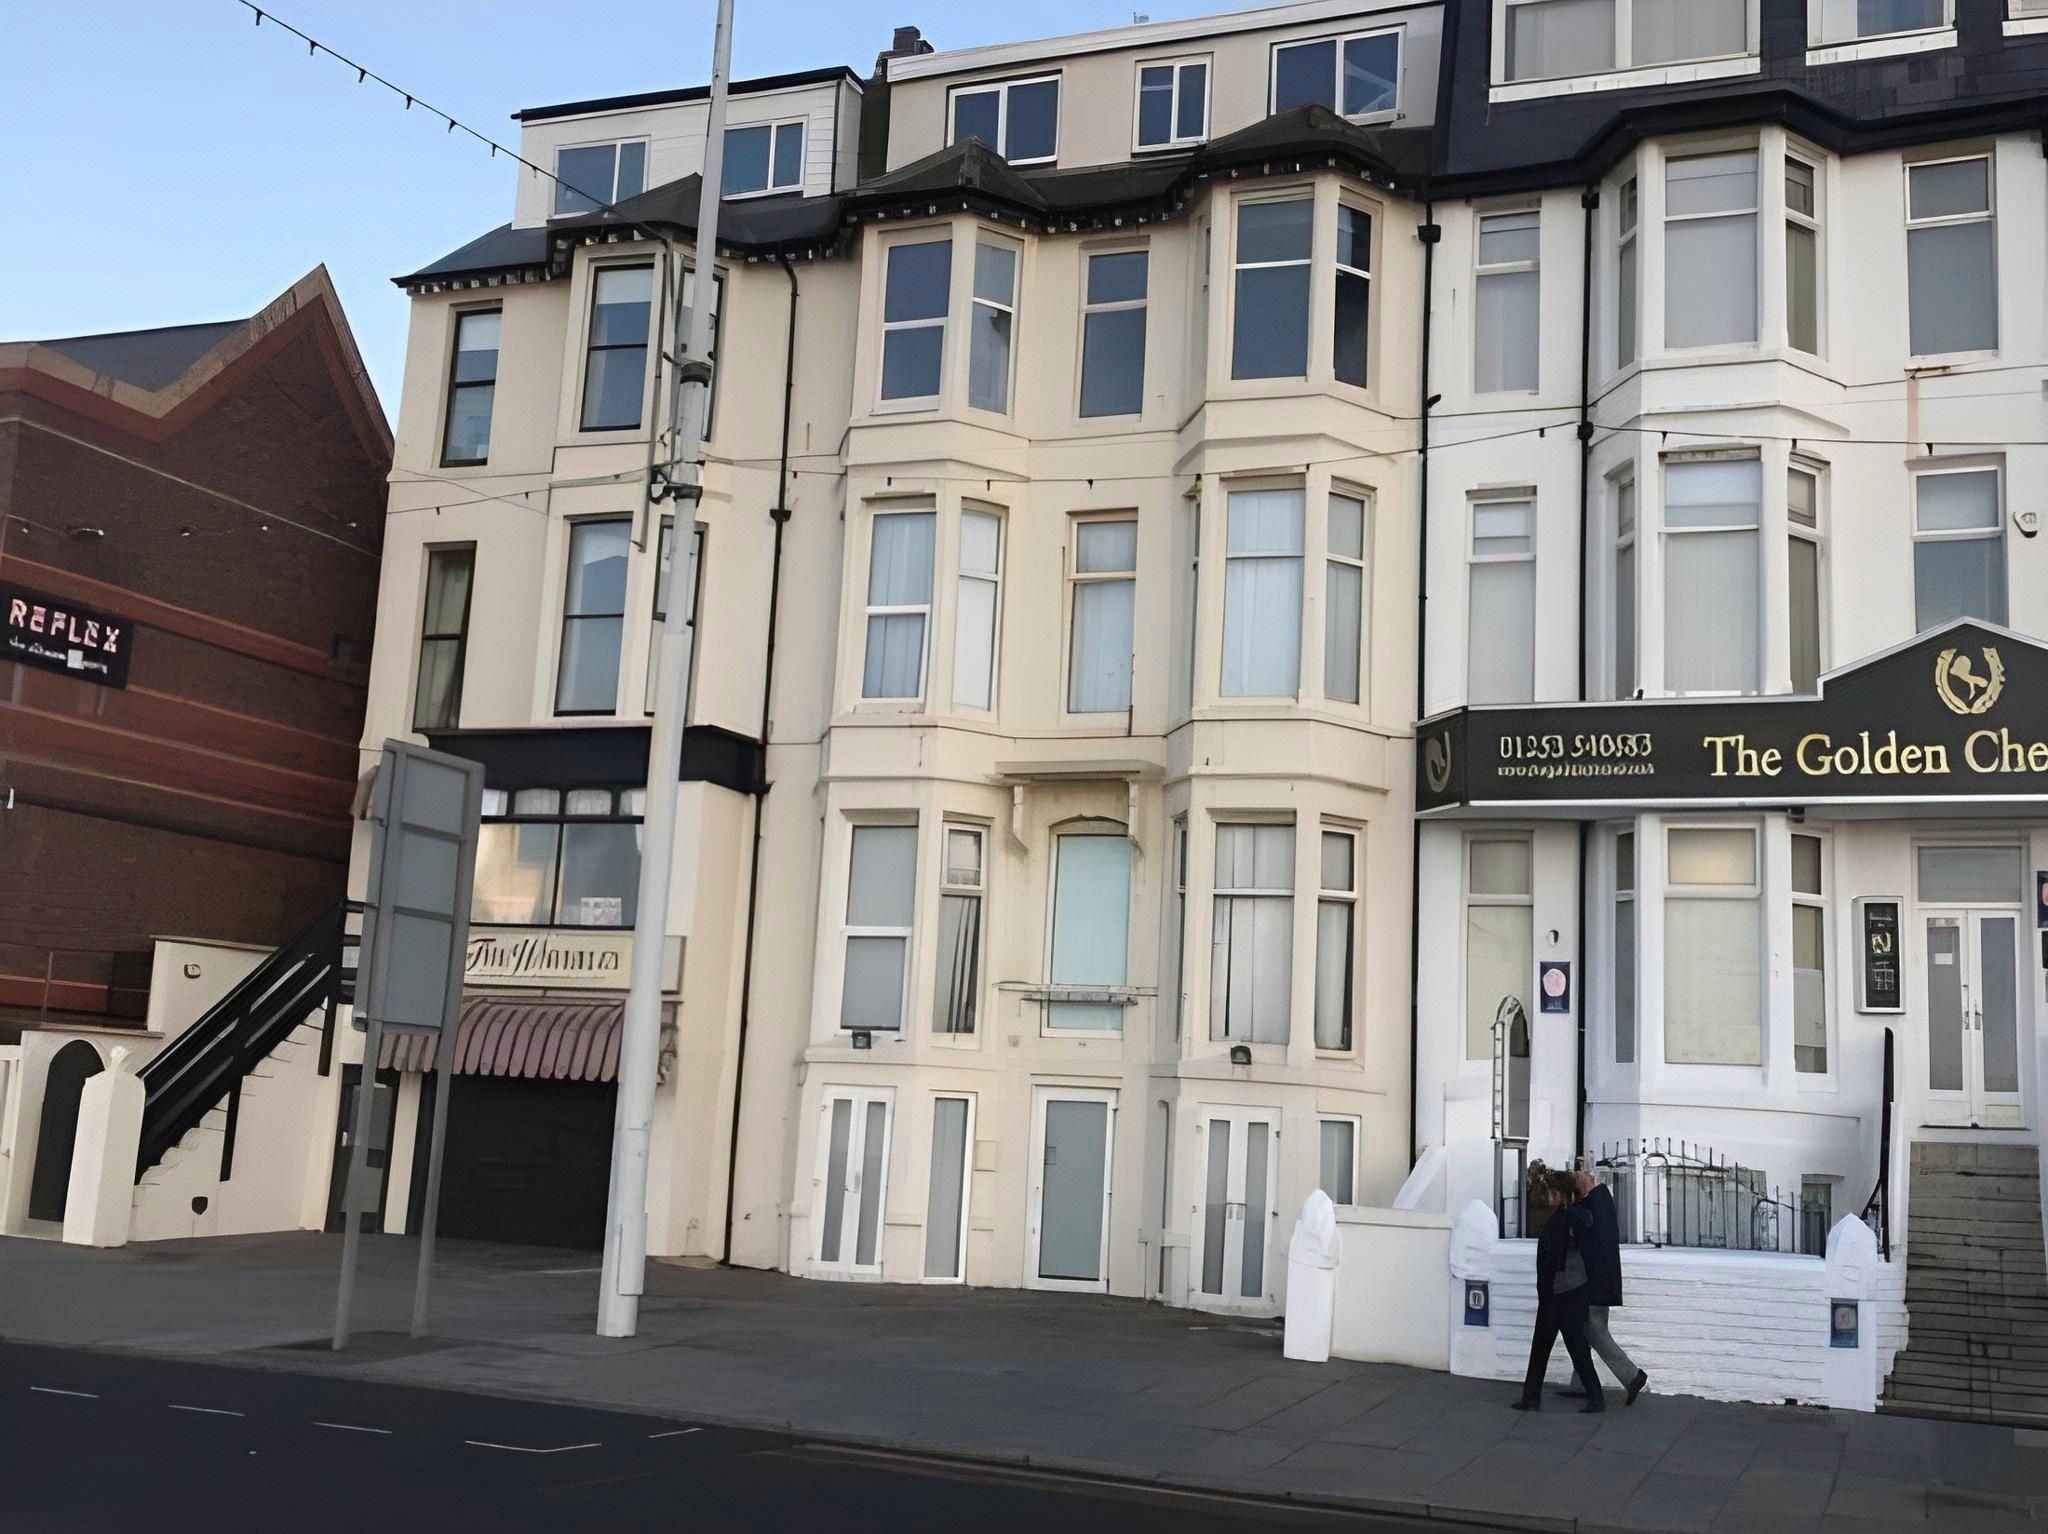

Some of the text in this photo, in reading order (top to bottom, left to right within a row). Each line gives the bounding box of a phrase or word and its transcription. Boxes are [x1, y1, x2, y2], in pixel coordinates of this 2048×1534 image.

[9, 599, 120, 653] REFLEX
[1703, 734, 1783, 777] The
[1796, 729, 1951, 776] Golden
